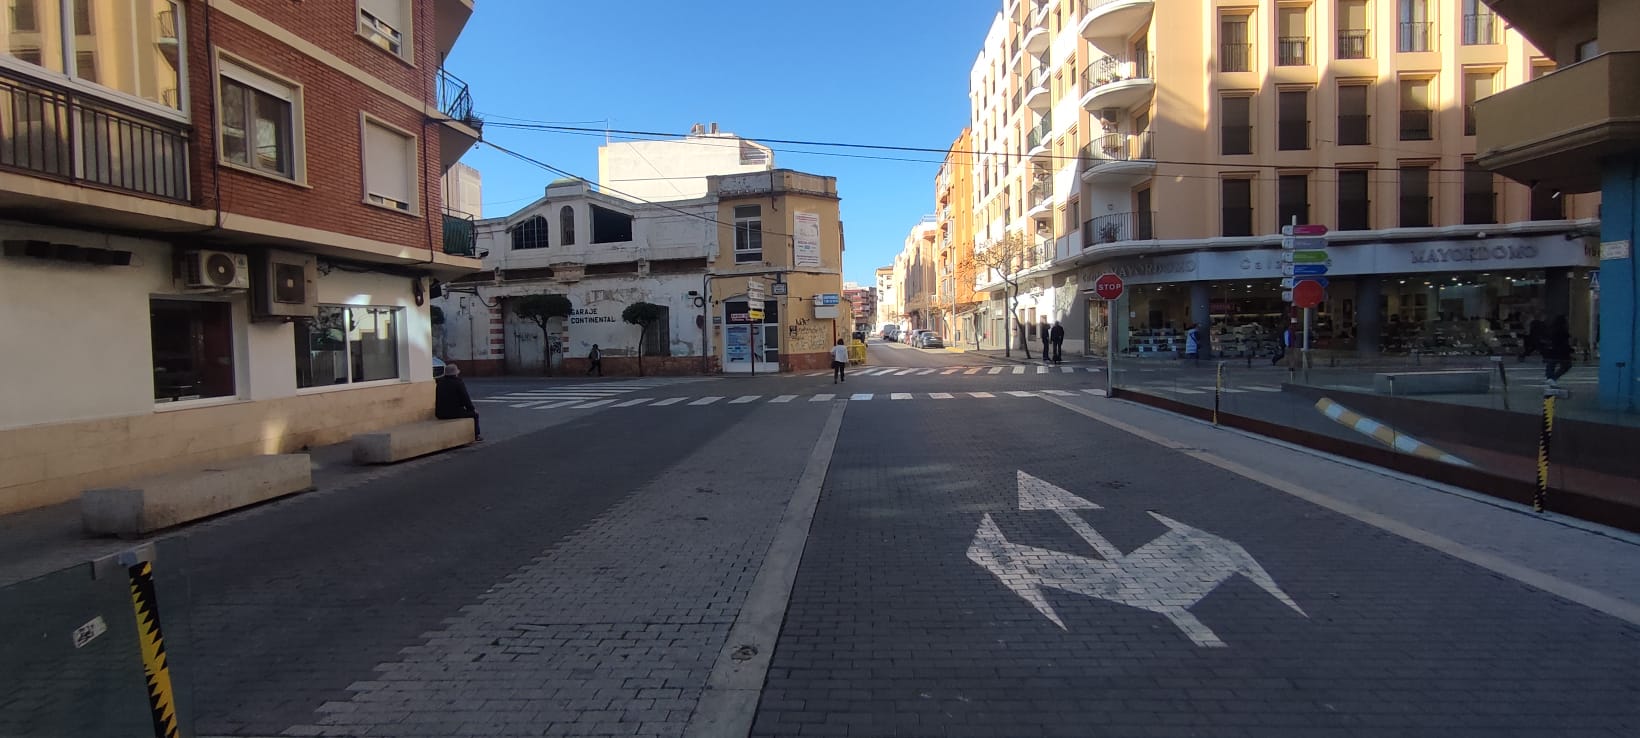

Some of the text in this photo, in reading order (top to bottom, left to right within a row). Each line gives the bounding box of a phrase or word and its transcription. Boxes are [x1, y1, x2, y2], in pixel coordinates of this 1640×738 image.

[1410, 245, 1539, 264] MAYORDOMO
[1098, 283, 1121, 291] STOP
[570, 308, 598, 316] GARAJE
[570, 315, 617, 325] CONTINENTAL
